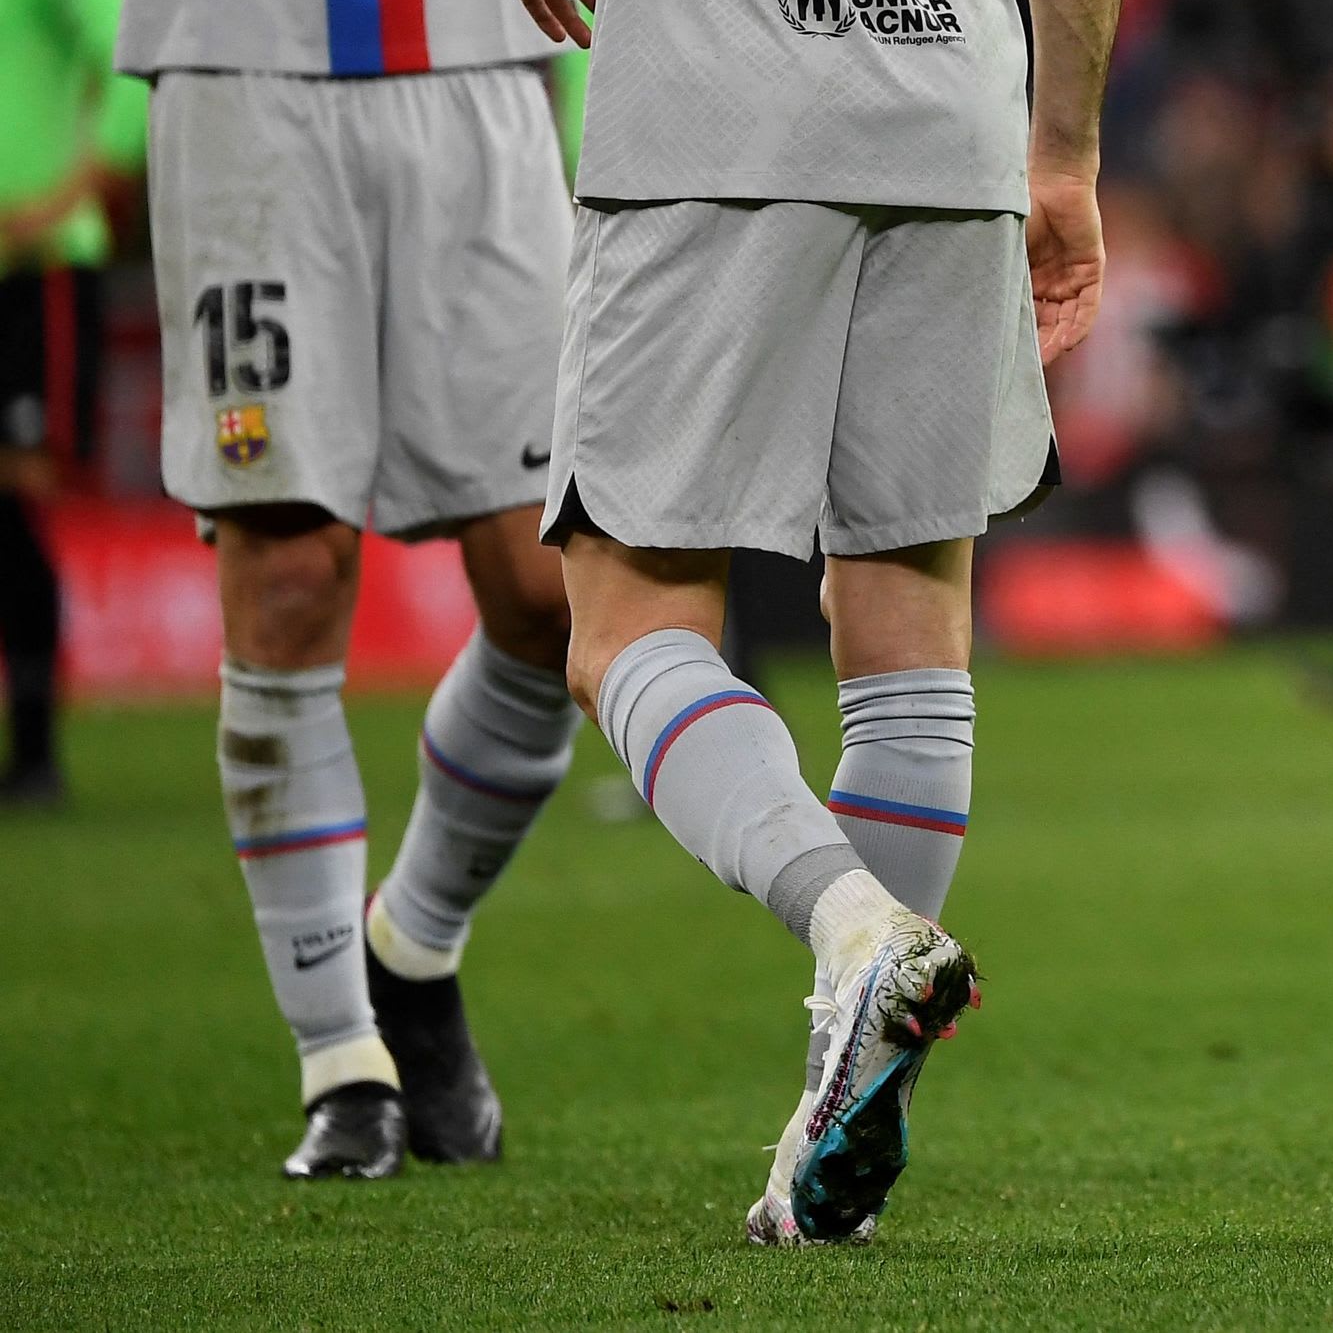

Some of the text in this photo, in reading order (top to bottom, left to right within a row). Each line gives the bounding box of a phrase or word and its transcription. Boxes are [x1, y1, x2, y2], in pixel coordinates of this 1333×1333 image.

[860, 8, 963, 34] ACNUR
[893, 35, 934, 46] Refugee
[193, 280, 291, 401] 15
